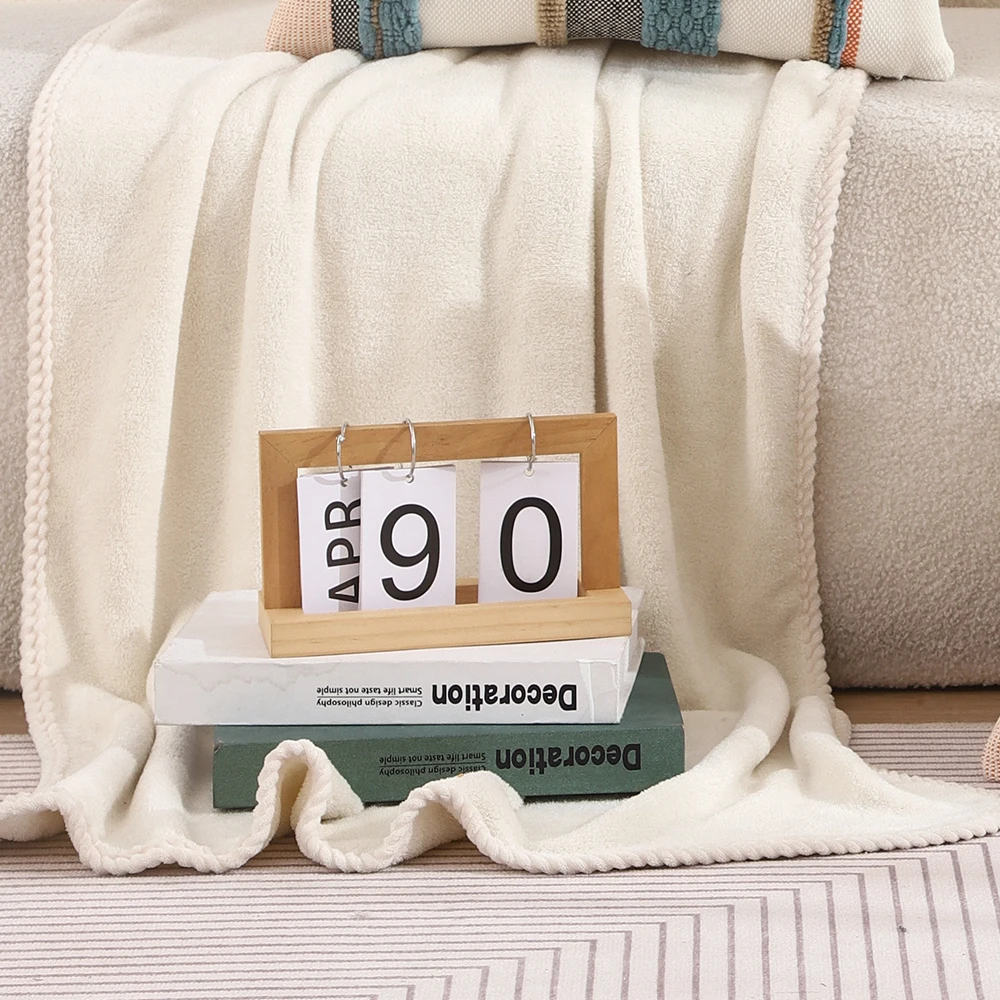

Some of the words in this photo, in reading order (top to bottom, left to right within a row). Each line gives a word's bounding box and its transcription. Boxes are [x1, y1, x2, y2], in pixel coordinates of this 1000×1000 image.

[324, 498, 361, 604] APR
[380, 503, 440, 601] 9
[499, 497, 563, 593] 0
[316, 686, 343, 695] simple
[345, 687, 359, 695] not
[361, 687, 381, 695] taste
[383, 687, 396, 695] life
[398, 687, 423, 695] Smart
[432, 684, 578, 711] Decoration
[316, 698, 362, 708] philosophy
[364, 698, 393, 708] design
[394, 699, 423, 708] Classic
[380, 755, 406, 765] simple
[424, 753, 445, 762] taste
[446, 753, 460, 762] life
[461, 752, 486, 761] Smart
[495, 743, 642, 775] Decoration
[379, 766, 426, 777] philosophy
[428, 764, 457, 775] design
